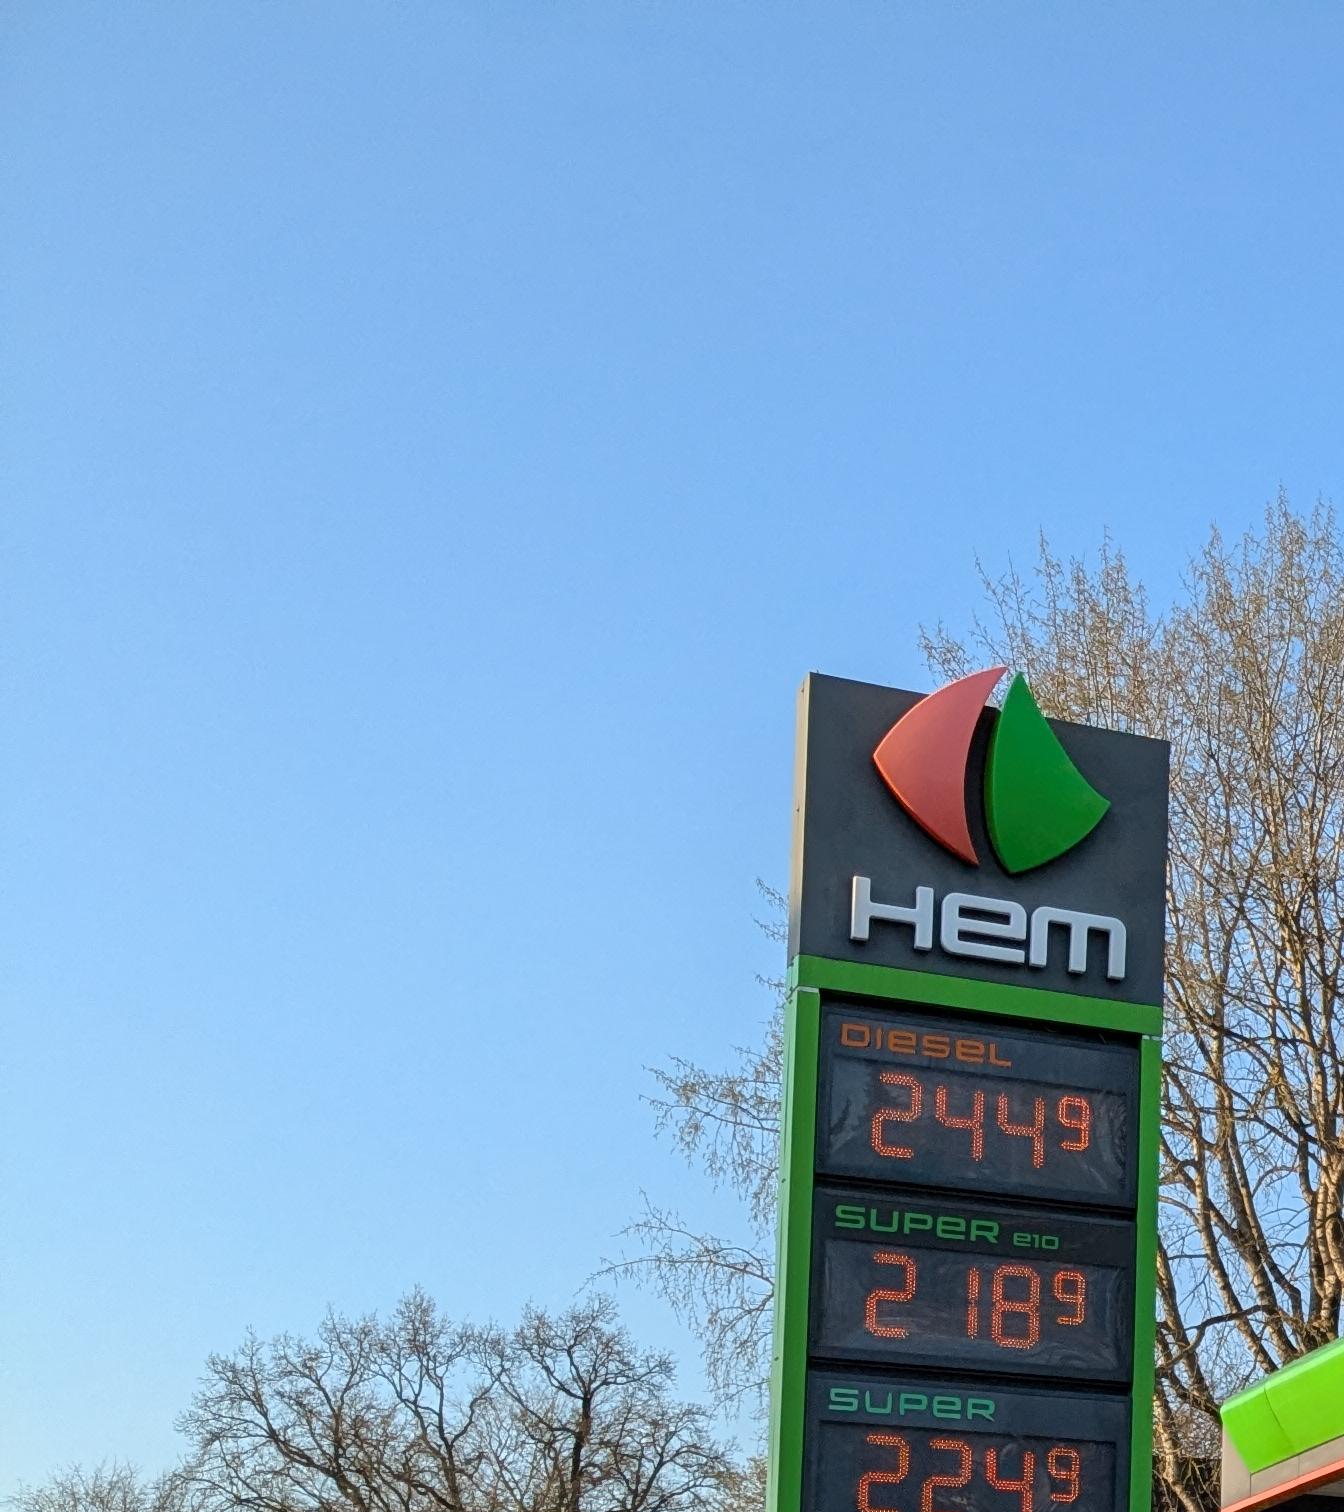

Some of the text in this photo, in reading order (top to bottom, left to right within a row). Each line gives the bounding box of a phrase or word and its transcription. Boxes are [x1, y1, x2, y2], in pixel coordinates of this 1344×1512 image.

[840, 1022, 1012, 1068] DIESEL
[834, 1204, 1000, 1244] SUPER
[828, 1387, 996, 1422] SUPER
